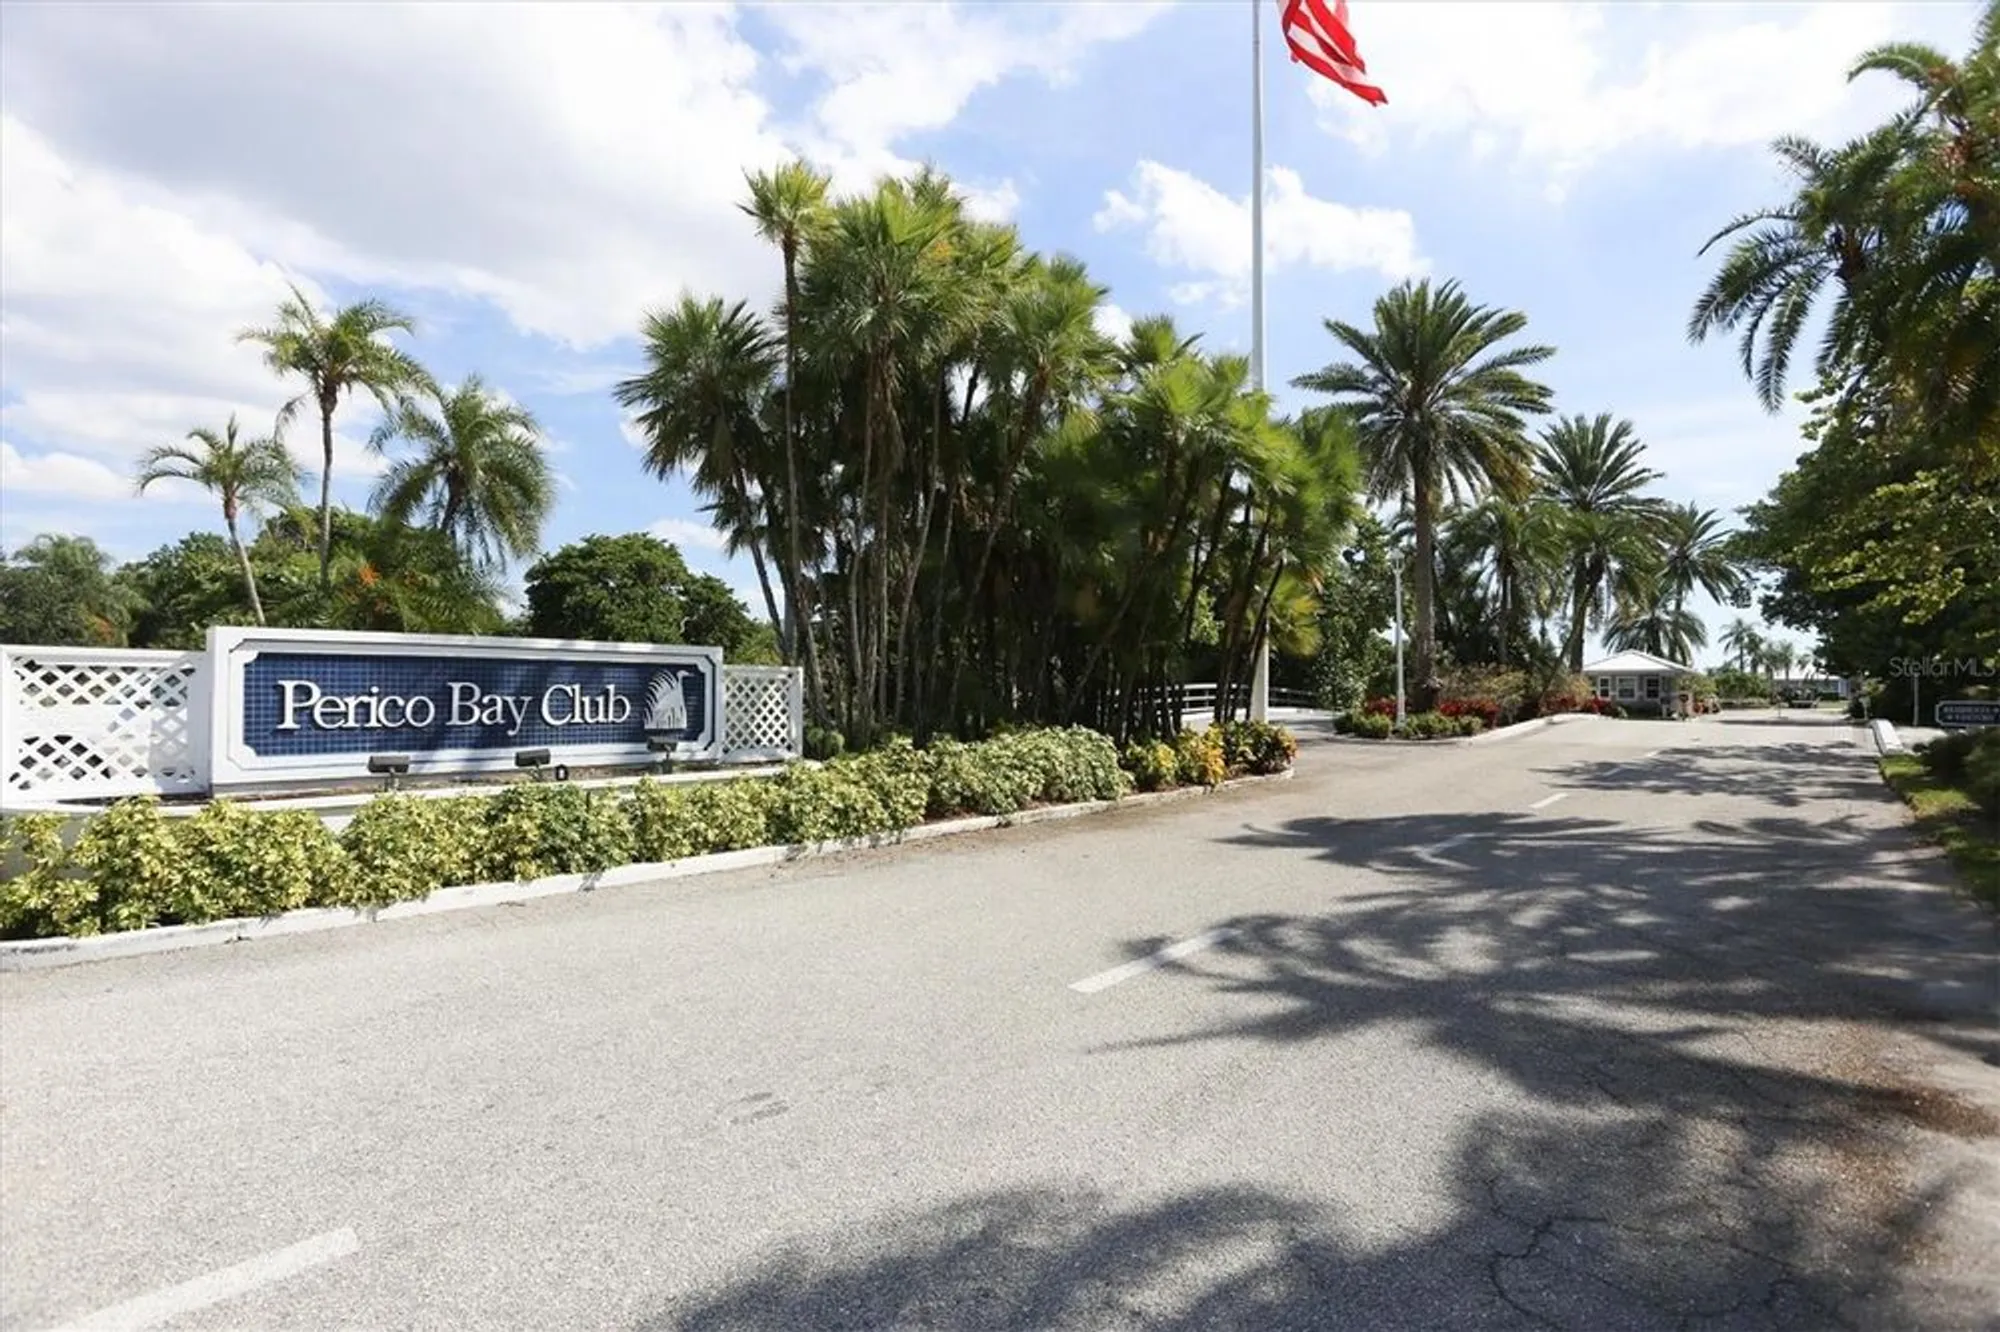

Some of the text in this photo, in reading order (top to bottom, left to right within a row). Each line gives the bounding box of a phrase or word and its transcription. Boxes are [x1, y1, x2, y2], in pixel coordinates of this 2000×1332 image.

[276, 678, 631, 735] Perico Bay Club
